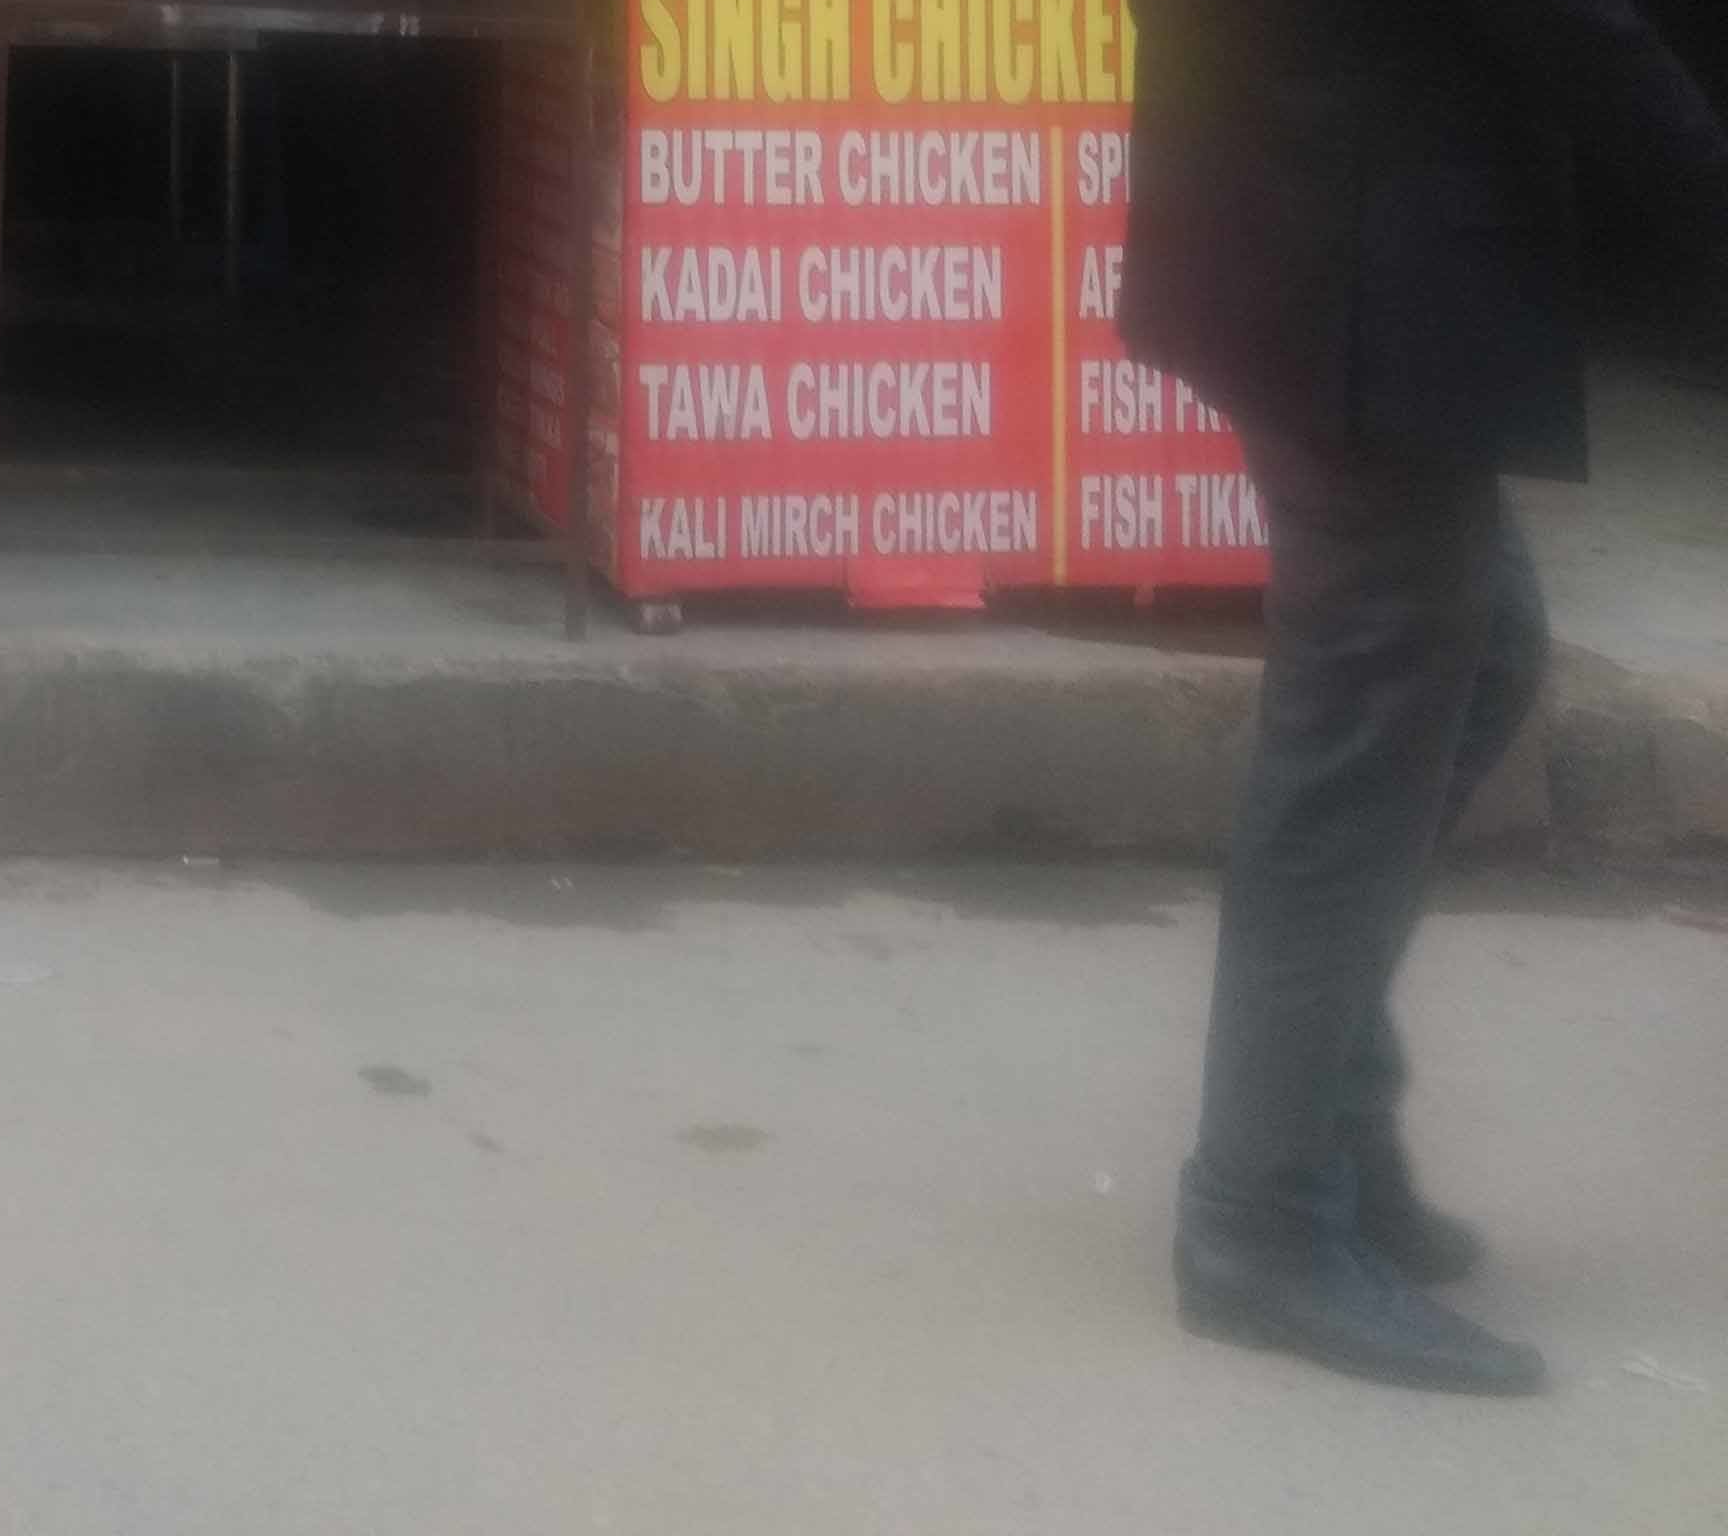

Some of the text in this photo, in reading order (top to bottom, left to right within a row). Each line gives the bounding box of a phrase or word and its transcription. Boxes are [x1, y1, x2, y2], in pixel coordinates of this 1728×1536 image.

[639, 129, 823, 205] BUTTER
[838, 131, 1042, 205] CHICKEN
[639, 245, 782, 322] KADAI
[798, 245, 1004, 322] CHICKEN
[639, 363, 774, 439] TAWA
[786, 361, 992, 438] CHICKEN
[1079, 359, 1163, 434] FISH
[639, 472, 1270, 559] KALI MIRCH CHICKEN FISH TIKK
